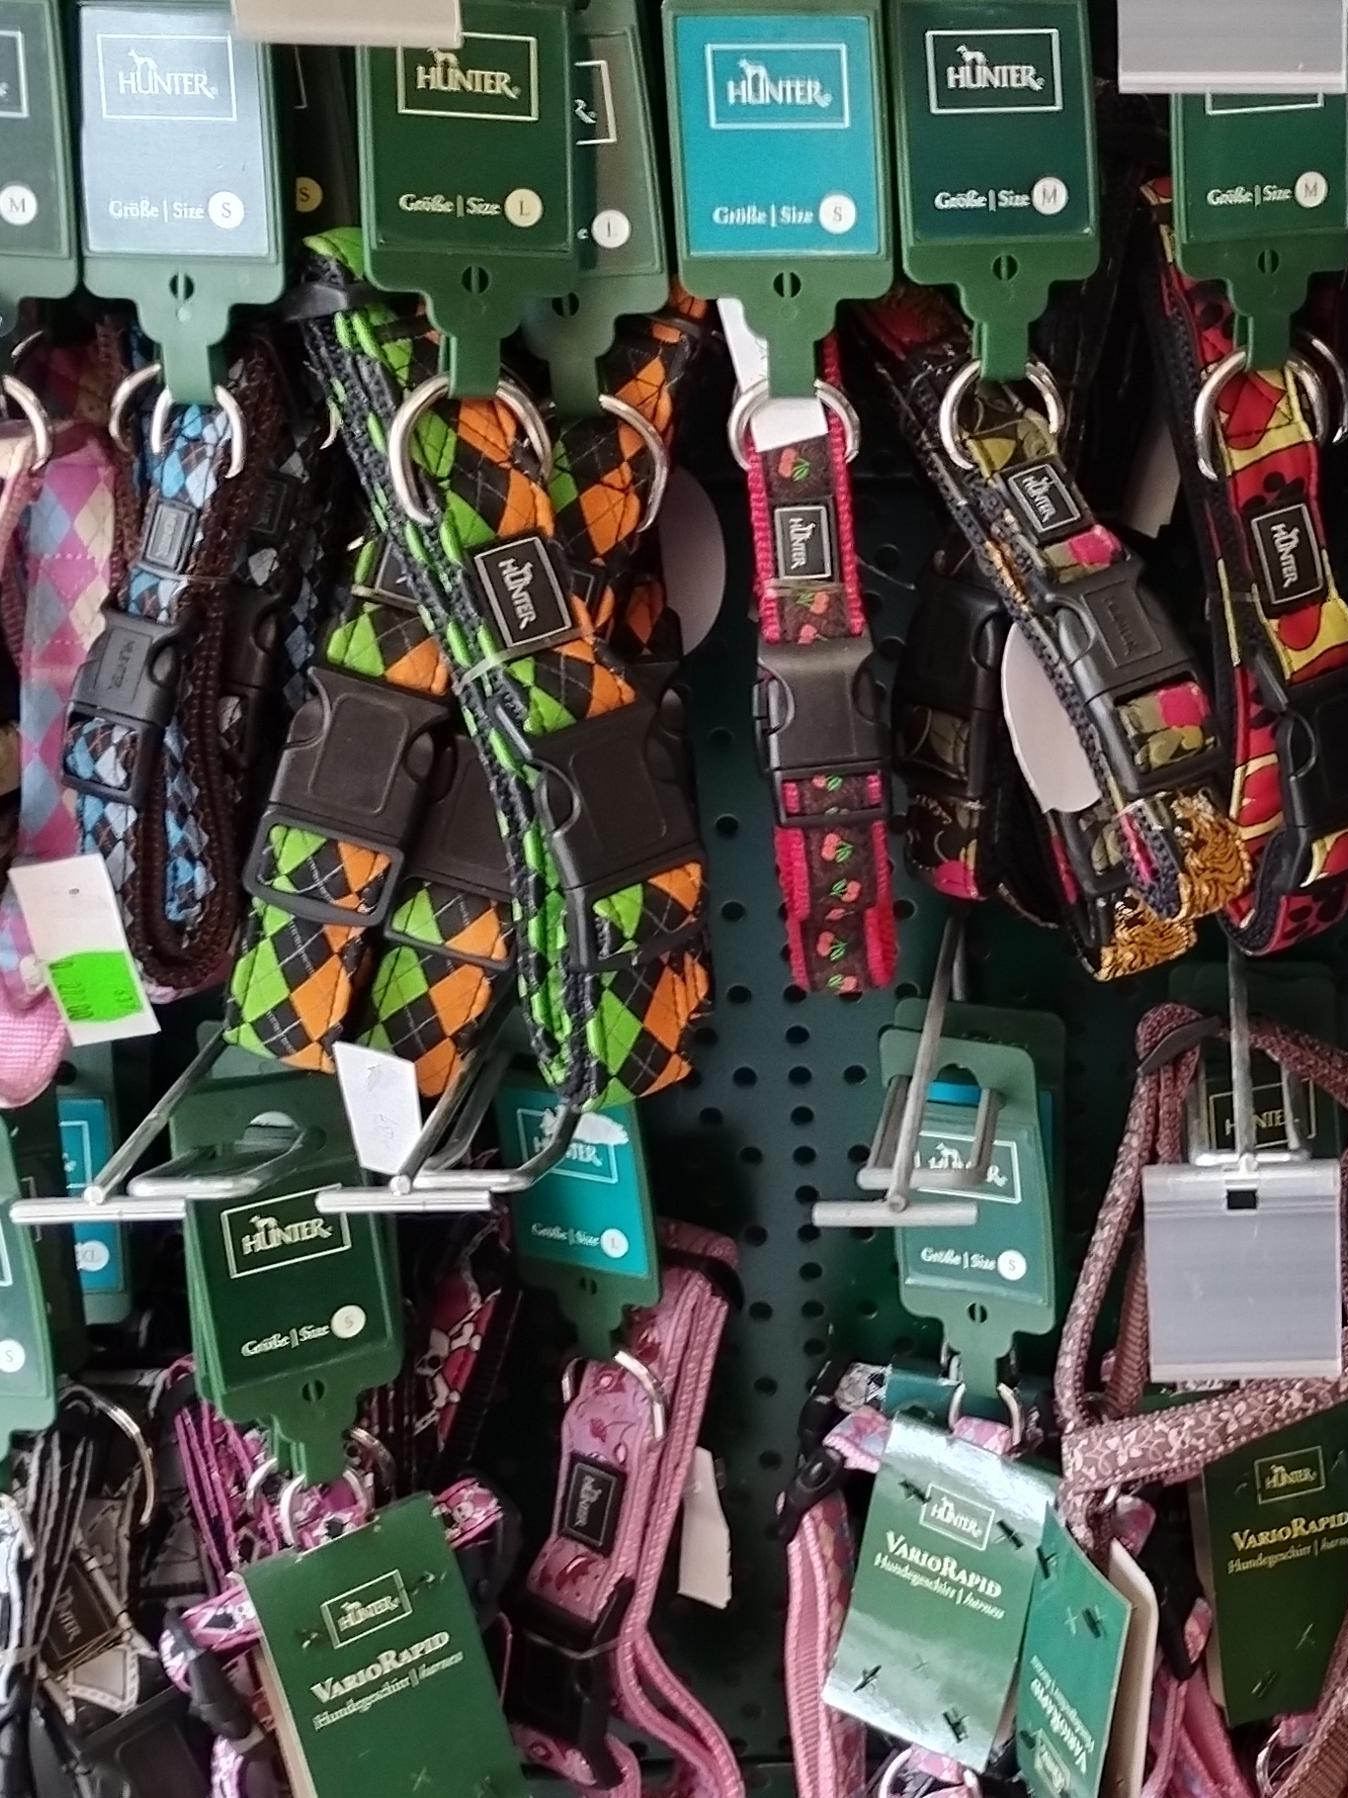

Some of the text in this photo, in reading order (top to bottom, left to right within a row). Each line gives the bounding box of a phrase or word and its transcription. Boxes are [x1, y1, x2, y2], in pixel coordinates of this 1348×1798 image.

[118, 66, 217, 100] HUNTER
[416, 60, 519, 99] HUNTER
[727, 74, 832, 108] HUNTER
[947, 61, 1046, 92] HUNTER
[109, 200, 159, 219] Größe
[172, 201, 205, 219] Size
[1022, 474, 1057, 523] HUNTER
[788, 517, 810, 570] HUNTER
[1271, 523, 1299, 588] HUNTER
[497, 557, 537, 631] HUNTER
[241, 1217, 332, 1256] HUNTER
[1264, 1464, 1318, 1490] HUNTER
[930, 1499, 982, 1538] HUNTER
